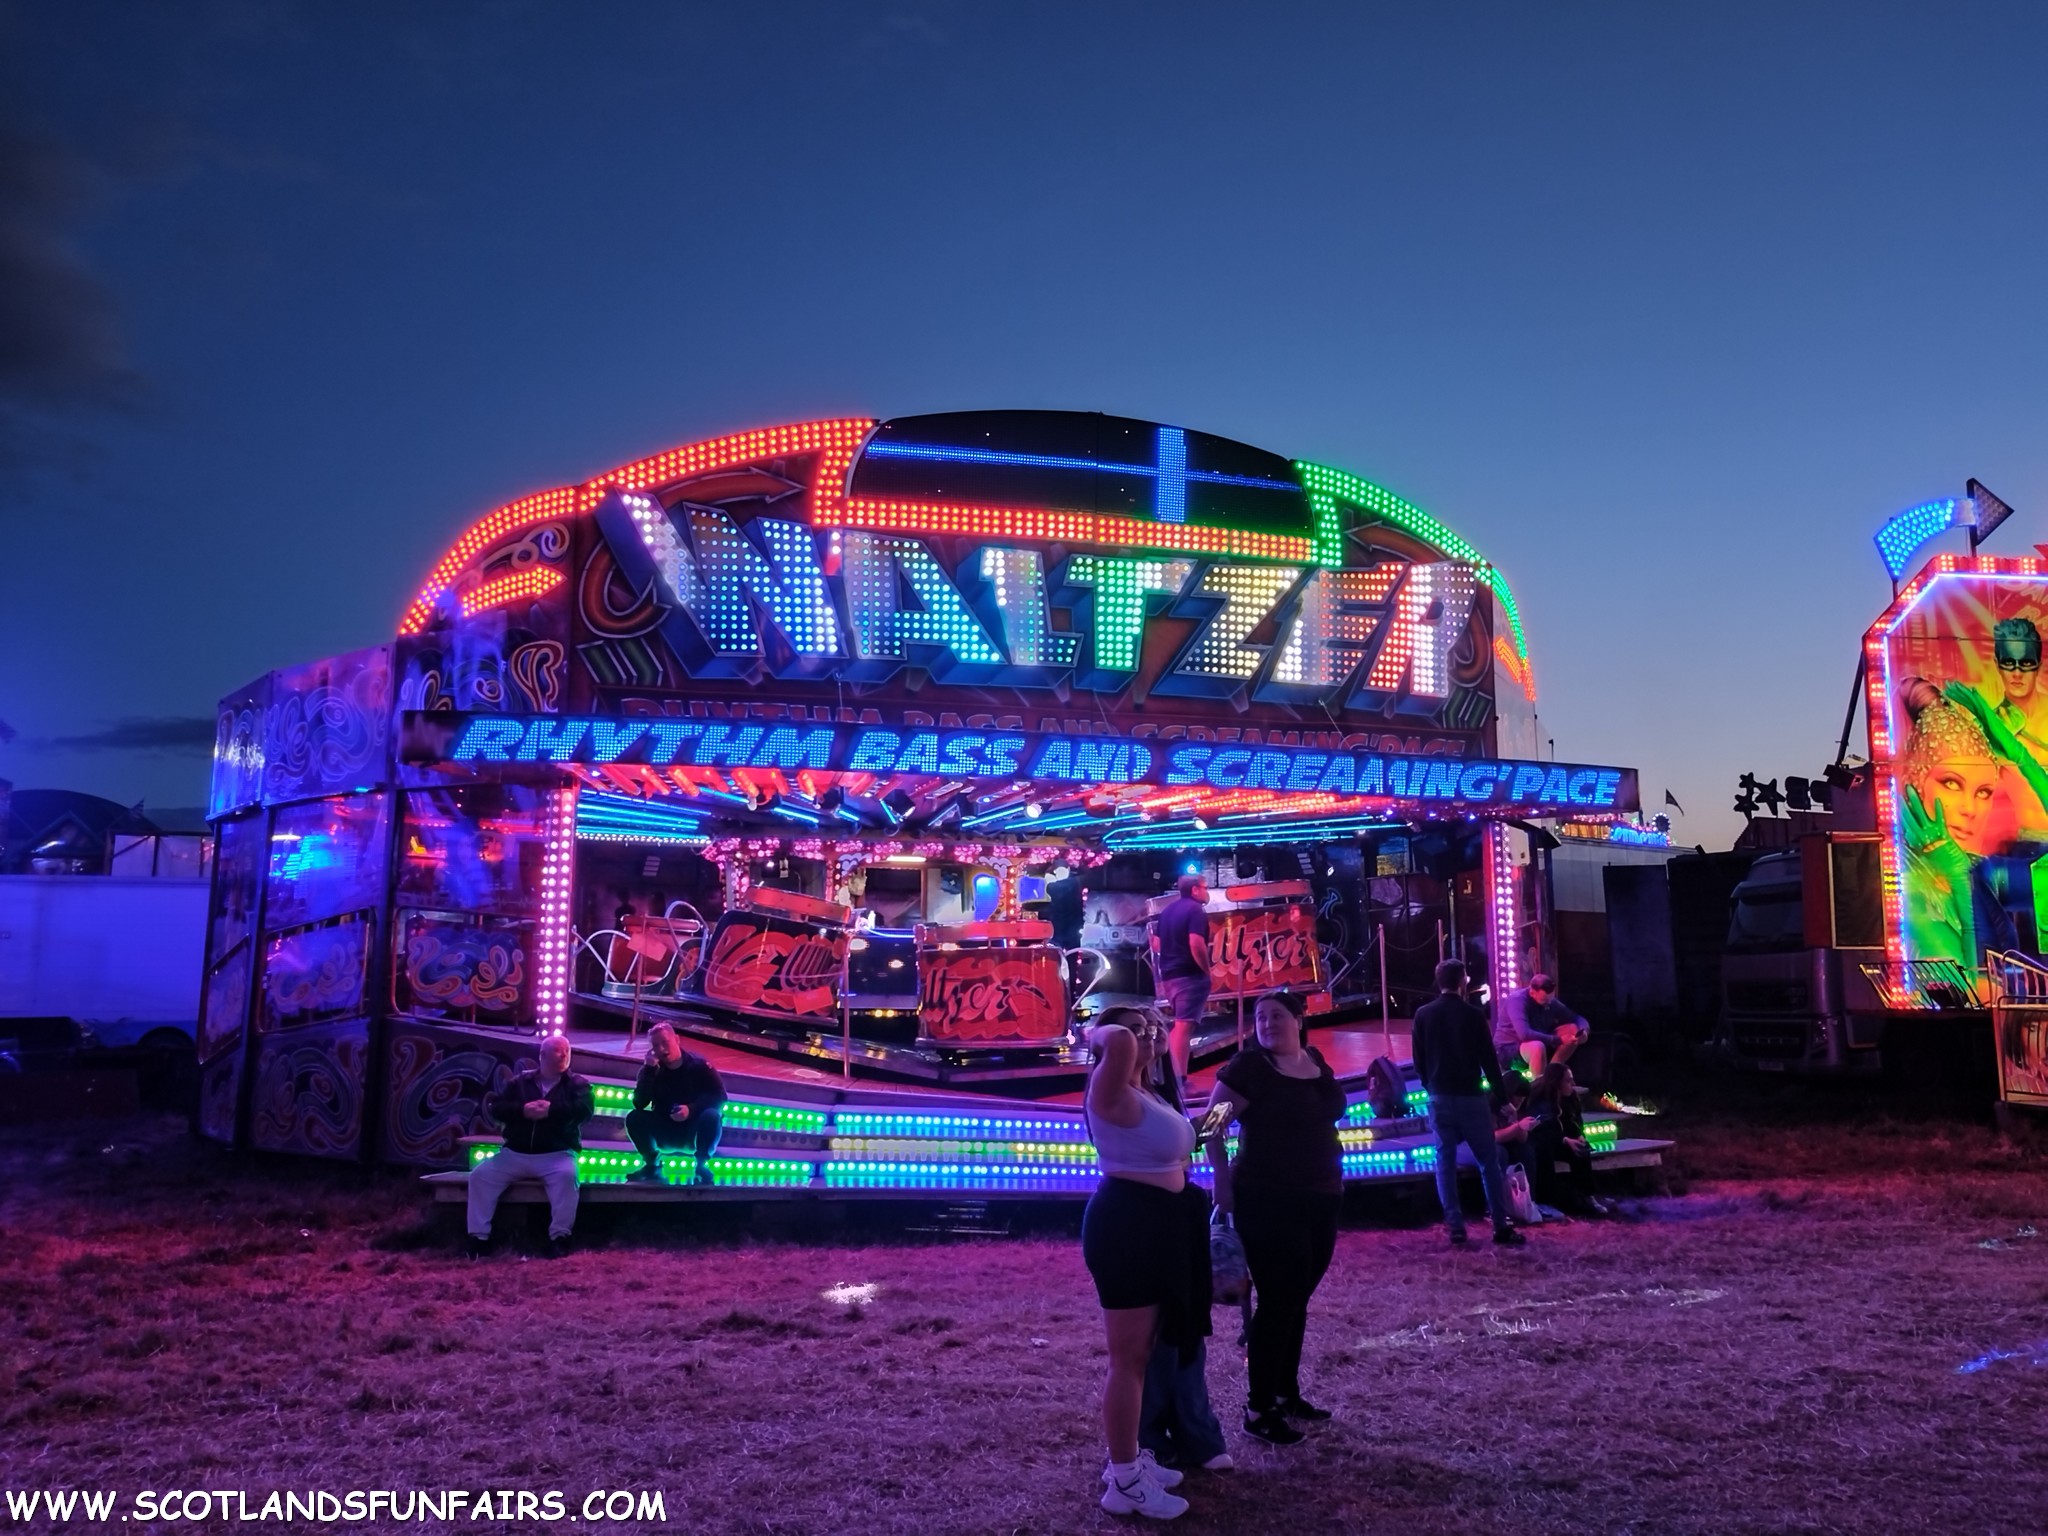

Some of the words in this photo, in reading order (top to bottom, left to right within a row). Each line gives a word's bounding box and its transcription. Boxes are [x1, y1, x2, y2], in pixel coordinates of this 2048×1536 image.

[610, 487, 1476, 698] WALTZER
[453, 718, 836, 769] RHYTHM
[848, 730, 1026, 777] BASS
[1032, 739, 1152, 782] AND
